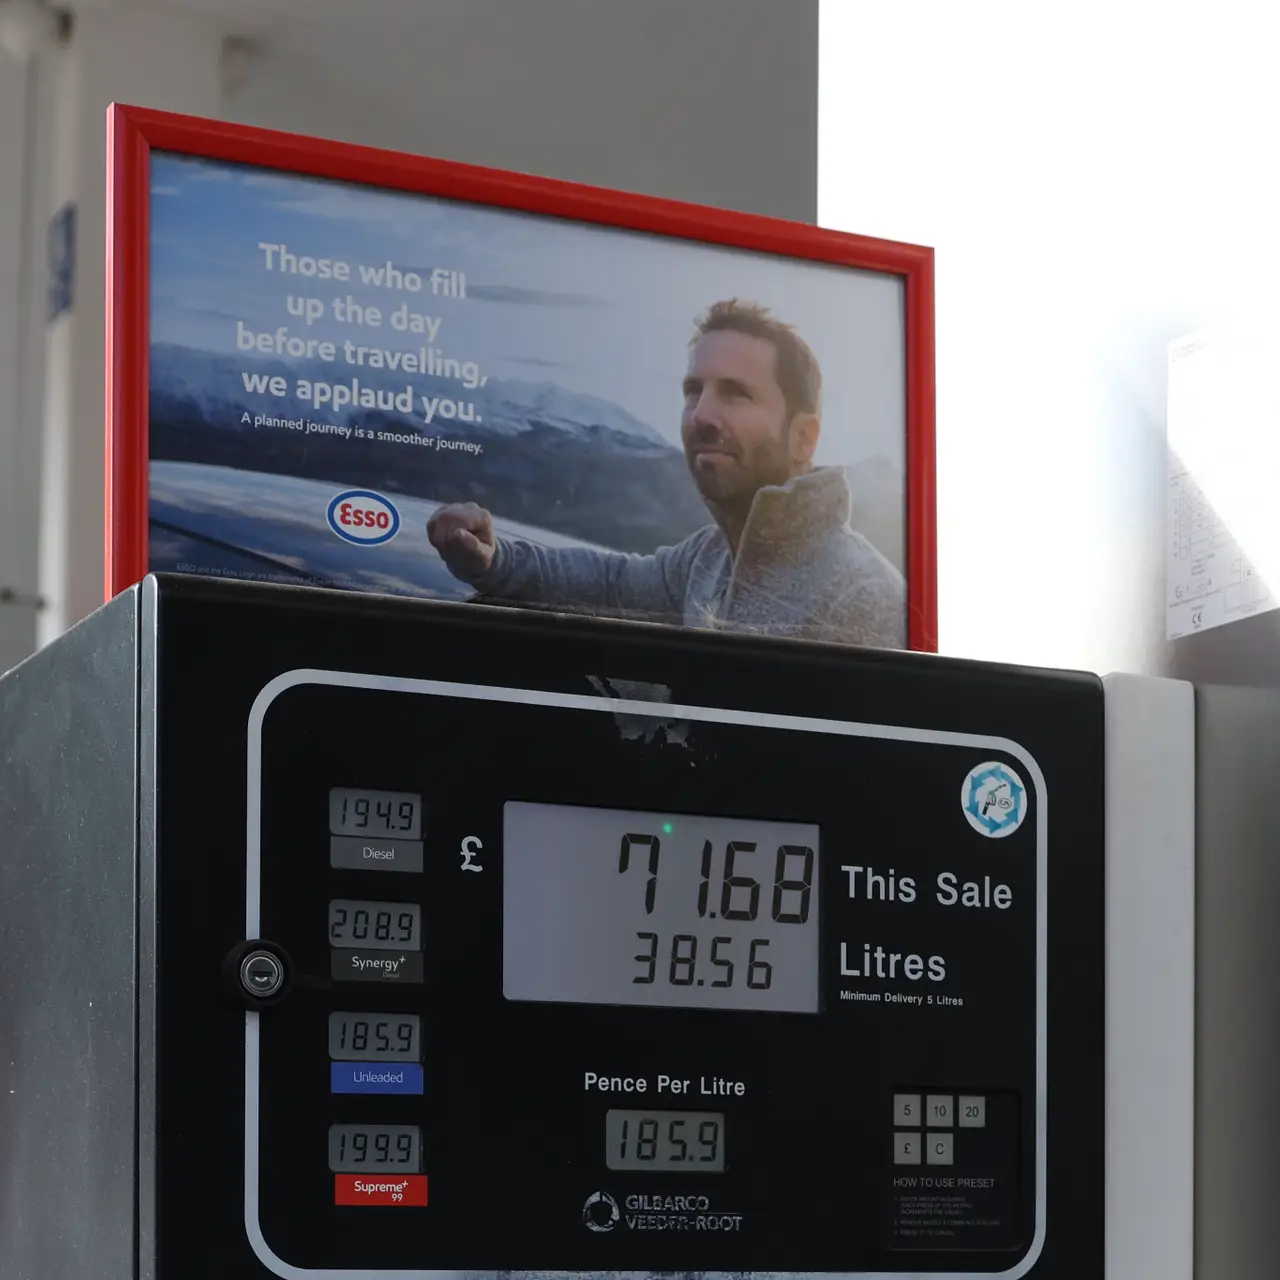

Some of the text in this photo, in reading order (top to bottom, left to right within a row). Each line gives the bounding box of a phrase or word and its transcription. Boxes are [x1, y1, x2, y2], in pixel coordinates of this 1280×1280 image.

[258, 242, 466, 299] Those who fill
[286, 294, 442, 343] up the day
[236, 321, 488, 389] before travelling,
[241, 372, 483, 425] we applaud you.
[241, 412, 483, 454] A planned journey is a smoother journey.
[339, 503, 390, 529] Esso
[341, 797, 414, 831] 194.9
[362, 847, 395, 860] Diesel
[460, 835, 484, 873] £
[619, 832, 815, 925] 71.68
[841, 865, 1012, 909] This Sale
[331, 909, 413, 942] 208.9
[632, 931, 773, 990] 38.56
[840, 942, 946, 981] Litres
[840, 991, 963, 1006] Minimum Delivery 5 Litres
[340, 1021, 413, 1052] 185.9
[353, 1071, 404, 1083] Unleaded
[585, 1072, 746, 1096] Pence Per Litre
[904, 1104, 979, 1118] 5 10 20
[340, 1133, 412, 1163] 199.9
[620, 1119, 718, 1162] 185.9
[903, 1142, 944, 1155] £ C
[391, 1193, 404, 1202] 99
[893, 1177, 995, 1188] HOW TO USE PRESET
[625, 1195, 709, 1211] GILBARCO
